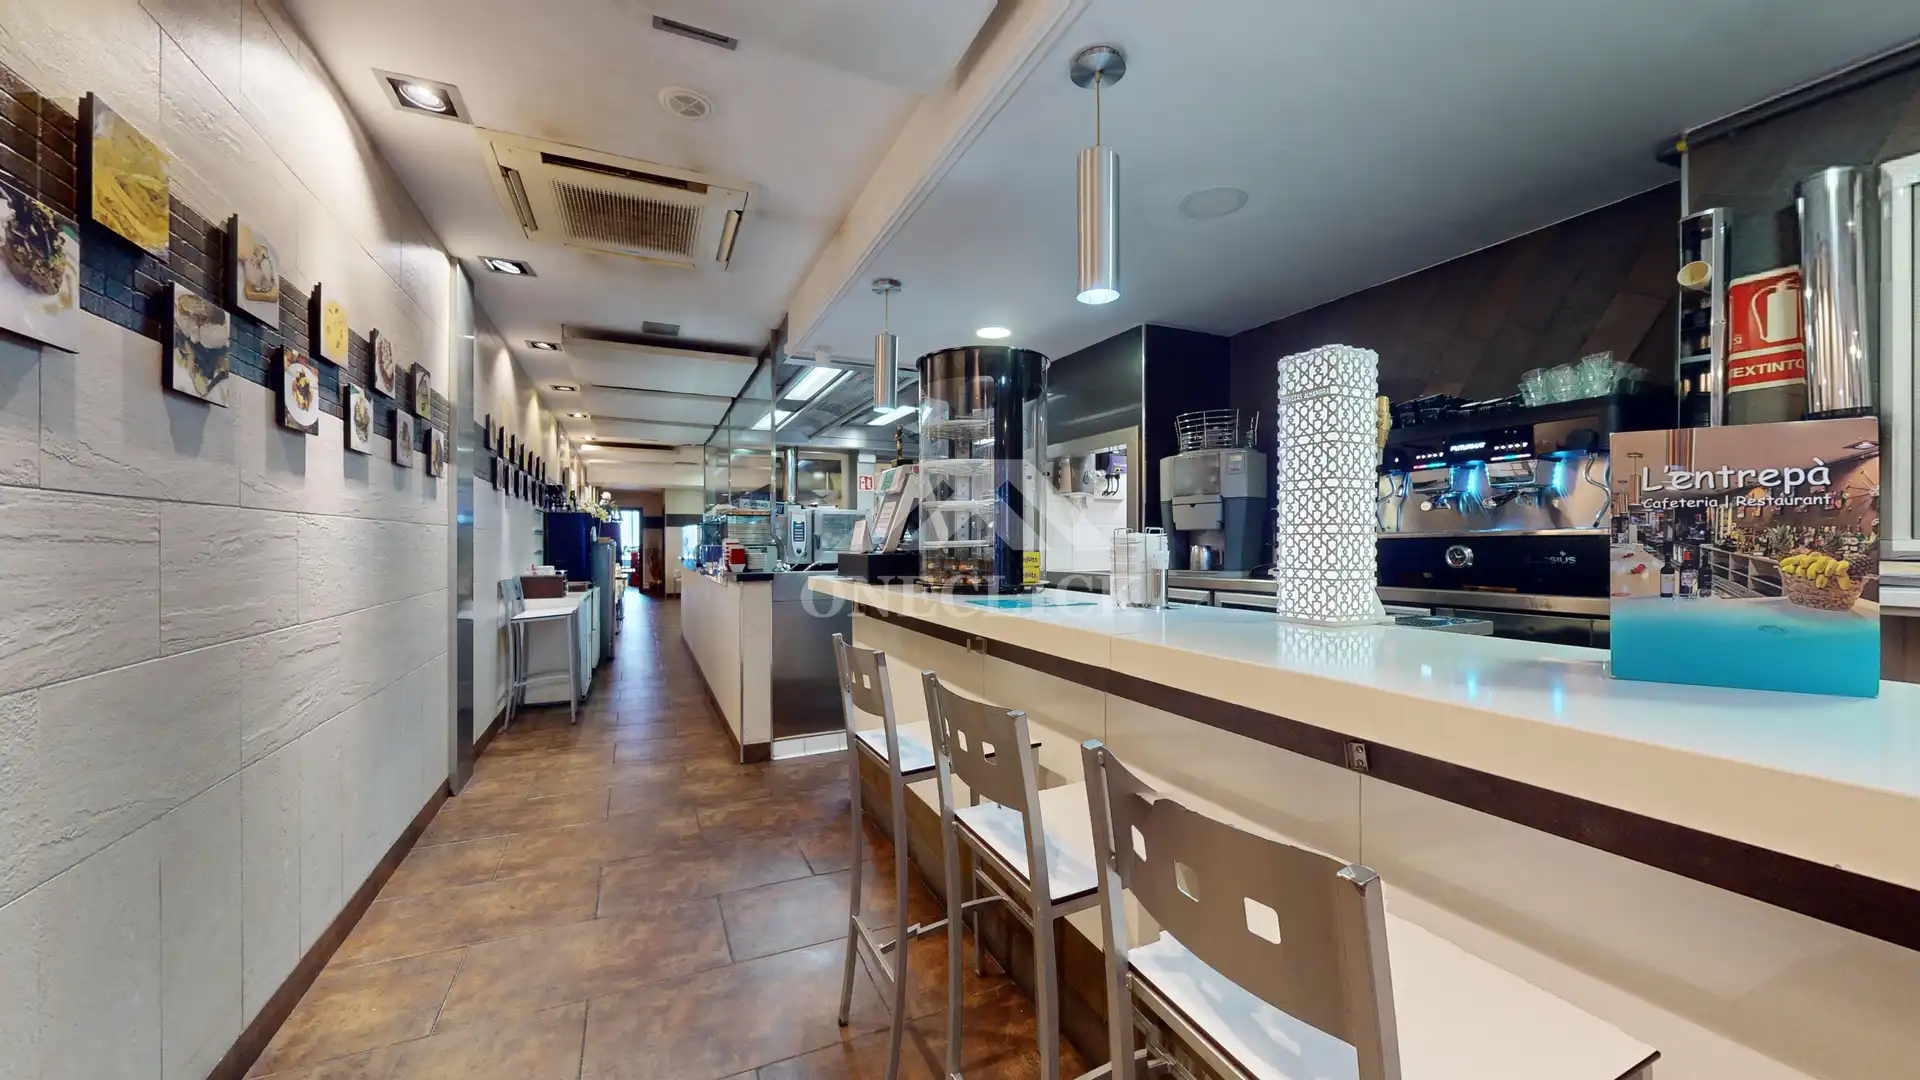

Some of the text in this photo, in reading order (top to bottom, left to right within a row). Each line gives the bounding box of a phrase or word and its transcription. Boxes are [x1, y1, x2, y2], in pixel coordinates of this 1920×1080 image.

[1641, 457, 1831, 495] L'entrepà
[1643, 496, 1719, 509] Cafeteria
[1736, 493, 1831, 507] Restaurant
